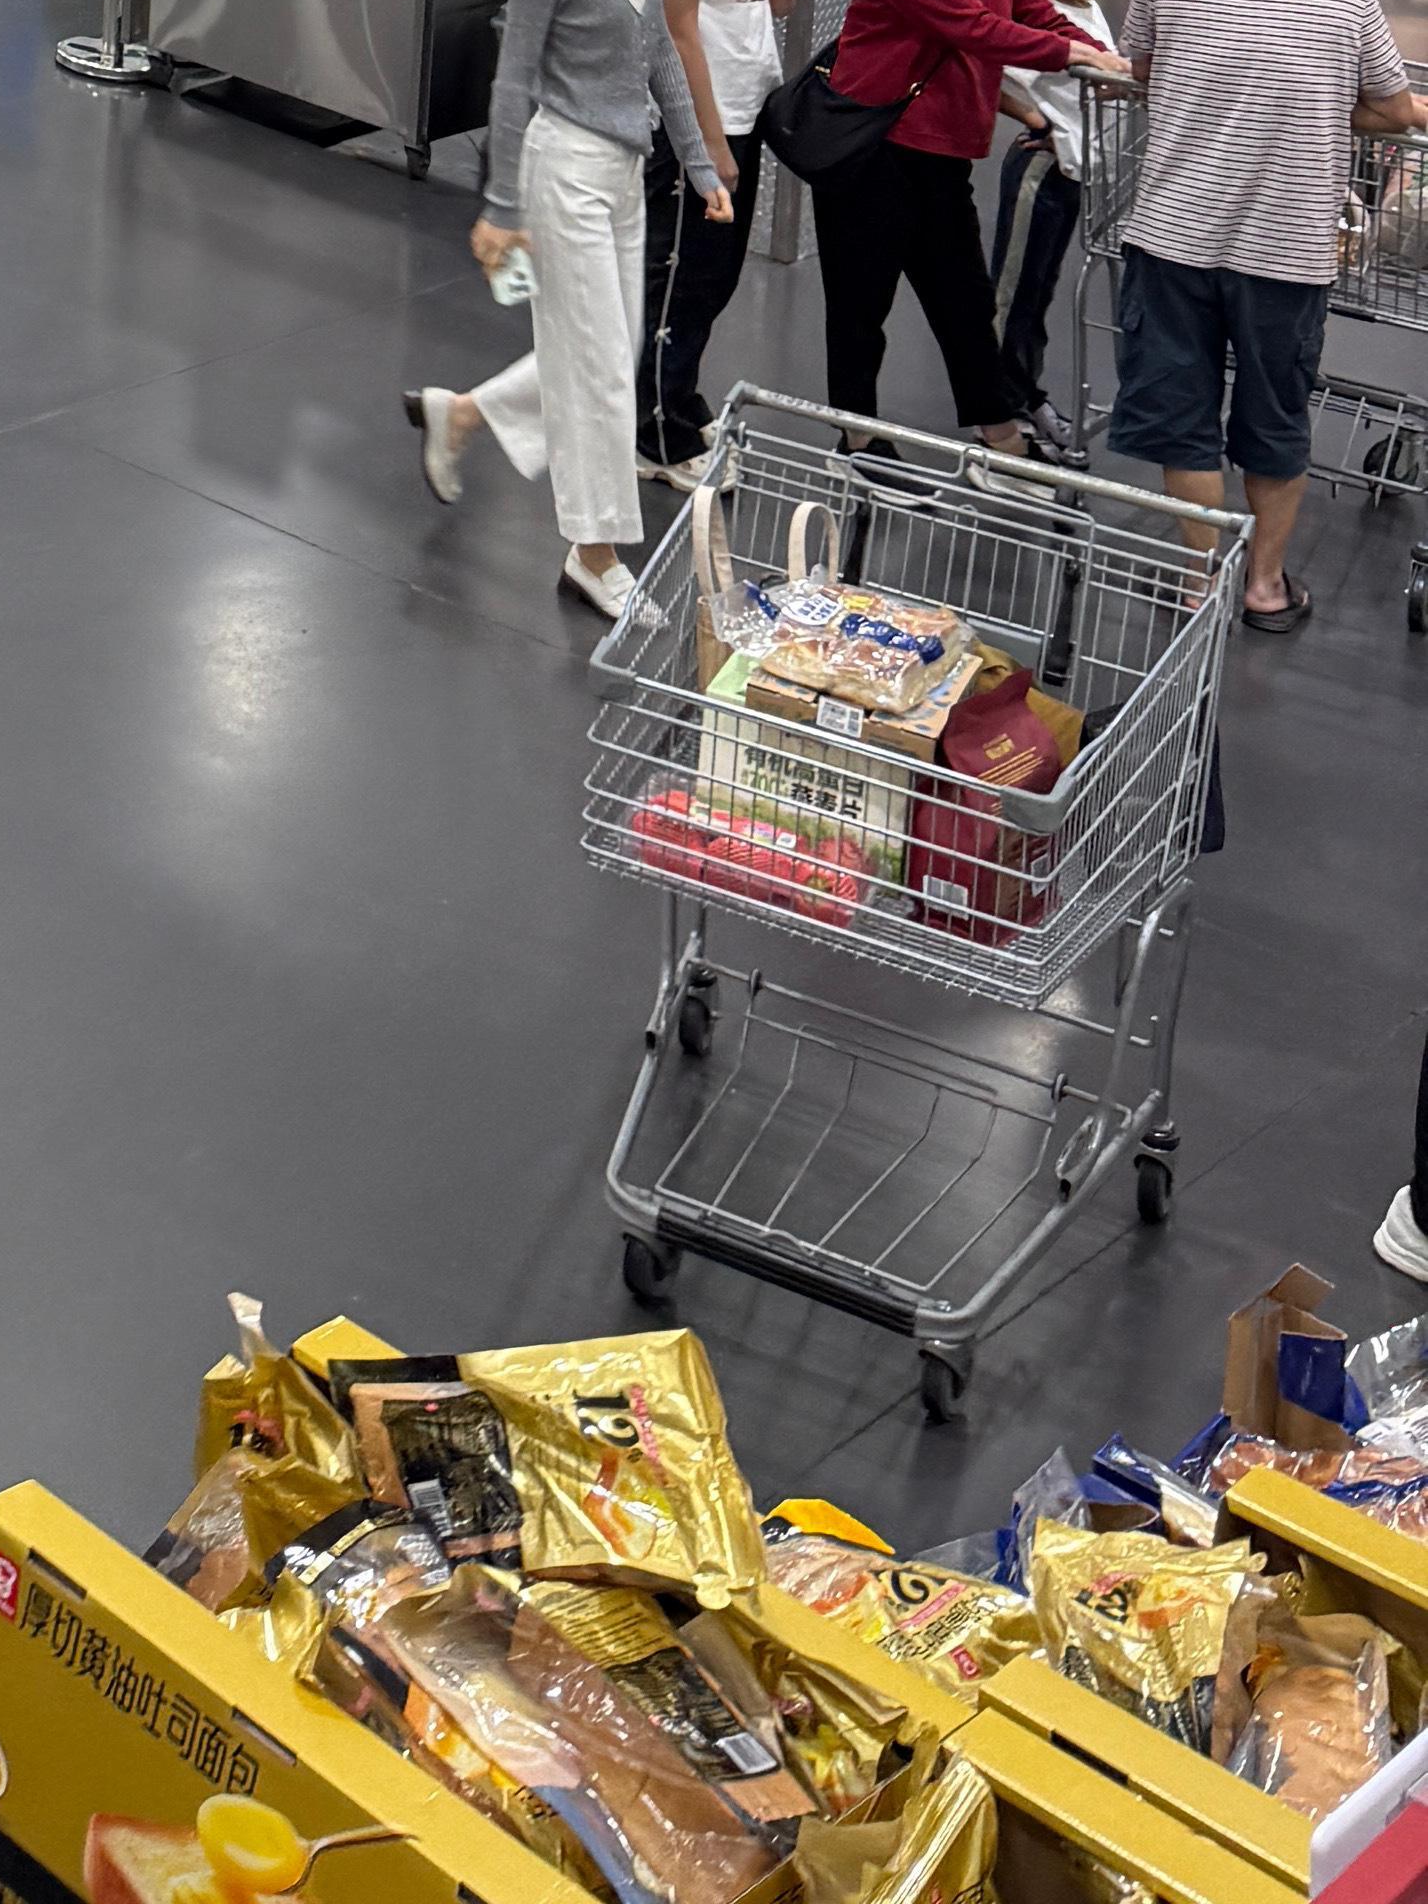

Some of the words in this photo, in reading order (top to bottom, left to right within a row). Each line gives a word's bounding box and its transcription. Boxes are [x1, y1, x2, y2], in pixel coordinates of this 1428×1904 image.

[18, 1582, 259, 1798] 厚切黄油吐司面包
